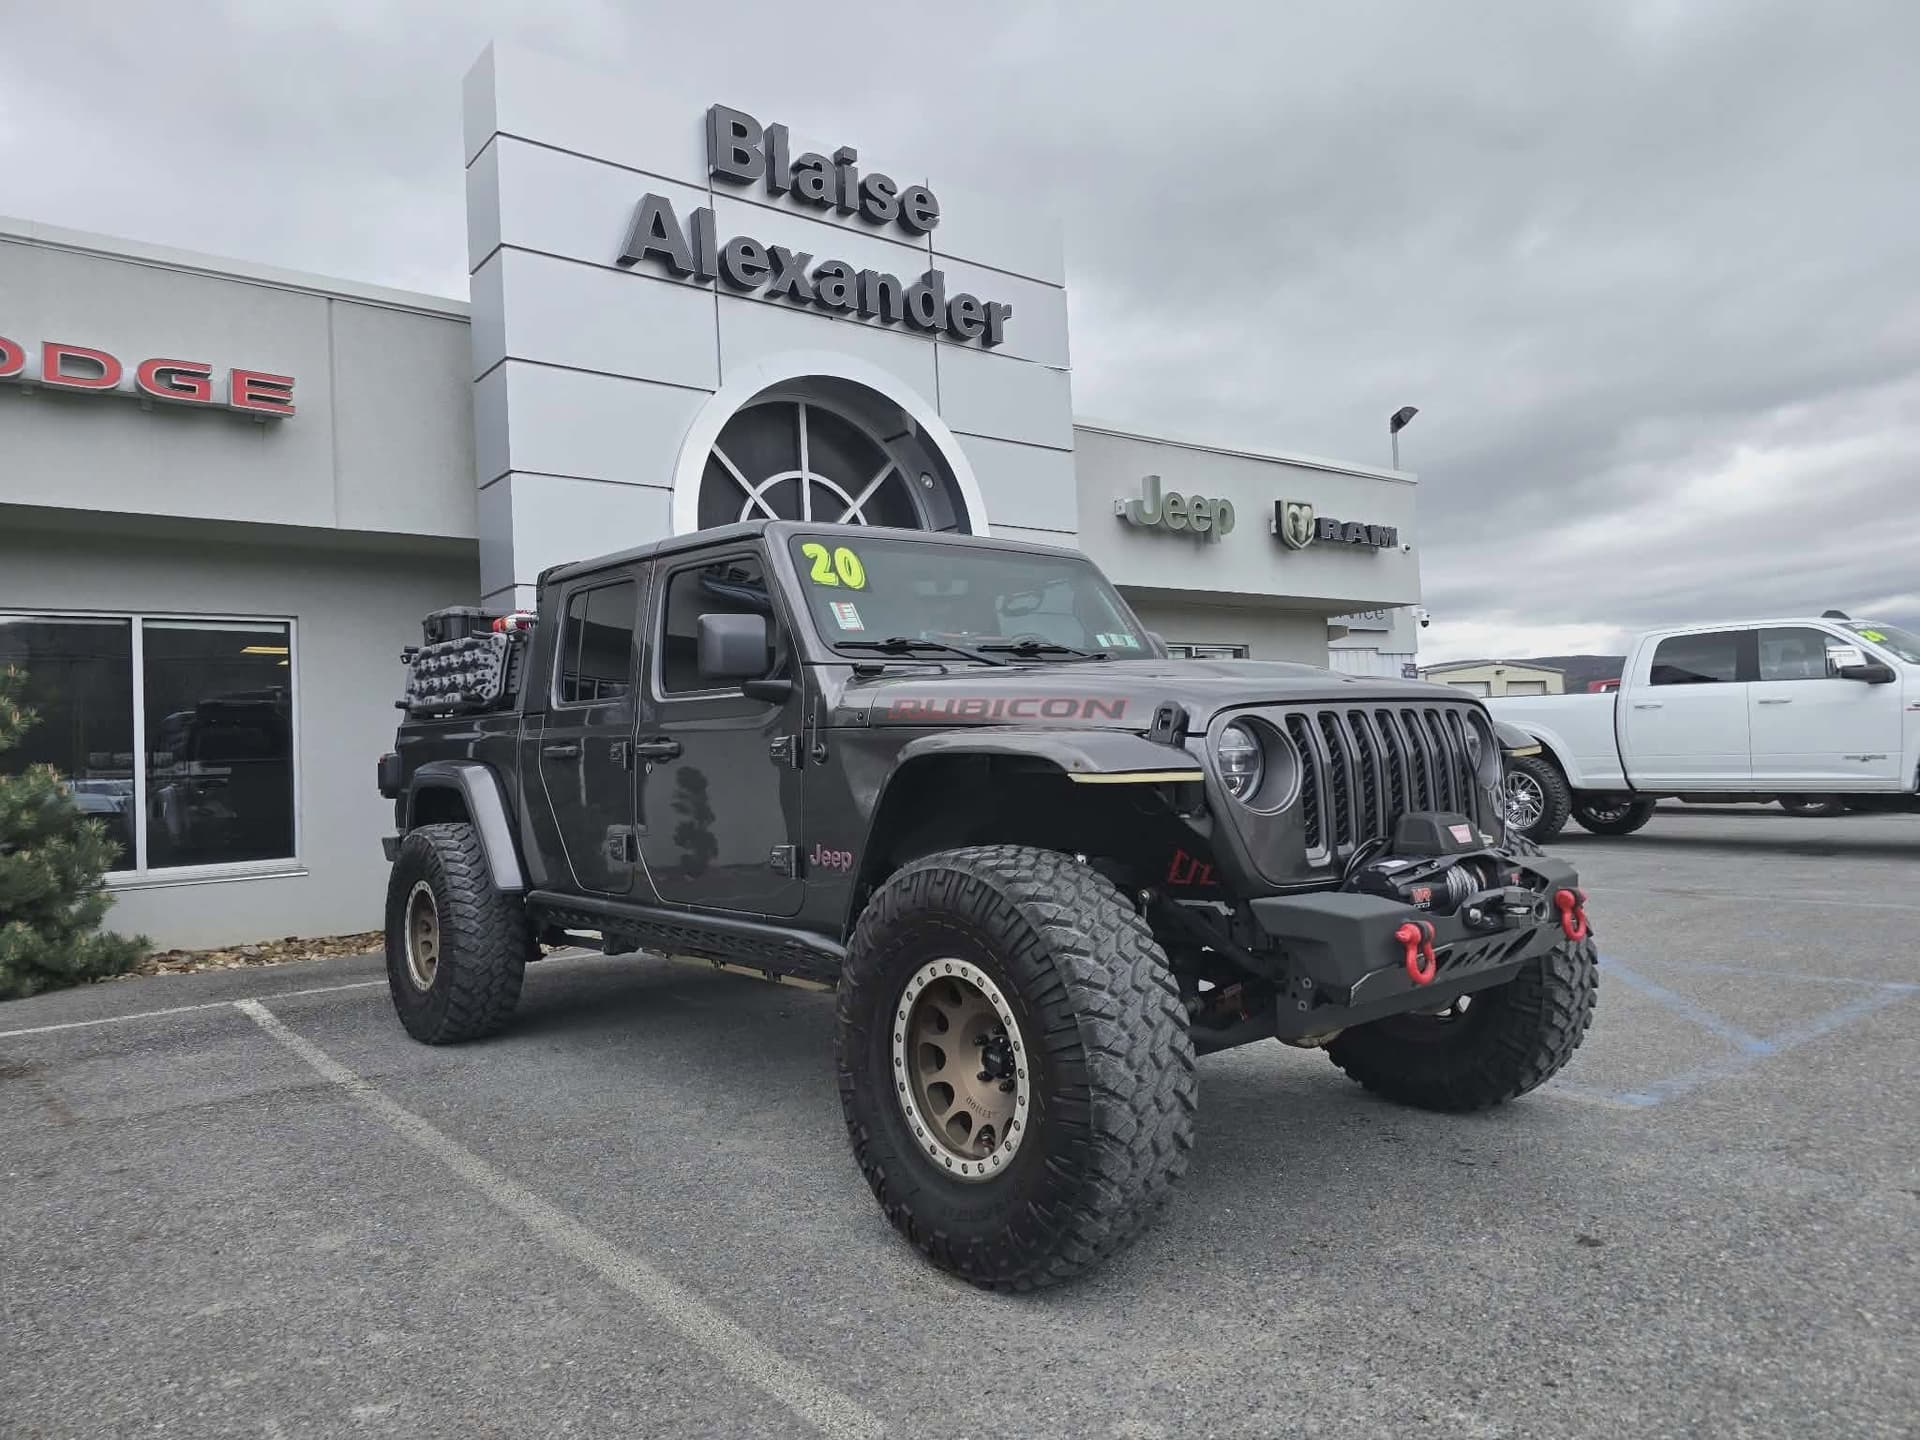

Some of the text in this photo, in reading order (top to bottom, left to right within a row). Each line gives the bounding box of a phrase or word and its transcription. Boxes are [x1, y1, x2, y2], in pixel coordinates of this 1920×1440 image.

[706, 103, 940, 236] Blaise
[617, 192, 1012, 348] Alexander
[1125, 475, 1236, 545] Jeep
[1315, 517, 1399, 548] RAM
[802, 543, 867, 589] 20
[887, 697, 1130, 720] RUBICON
[809, 843, 852, 872] Jeep
